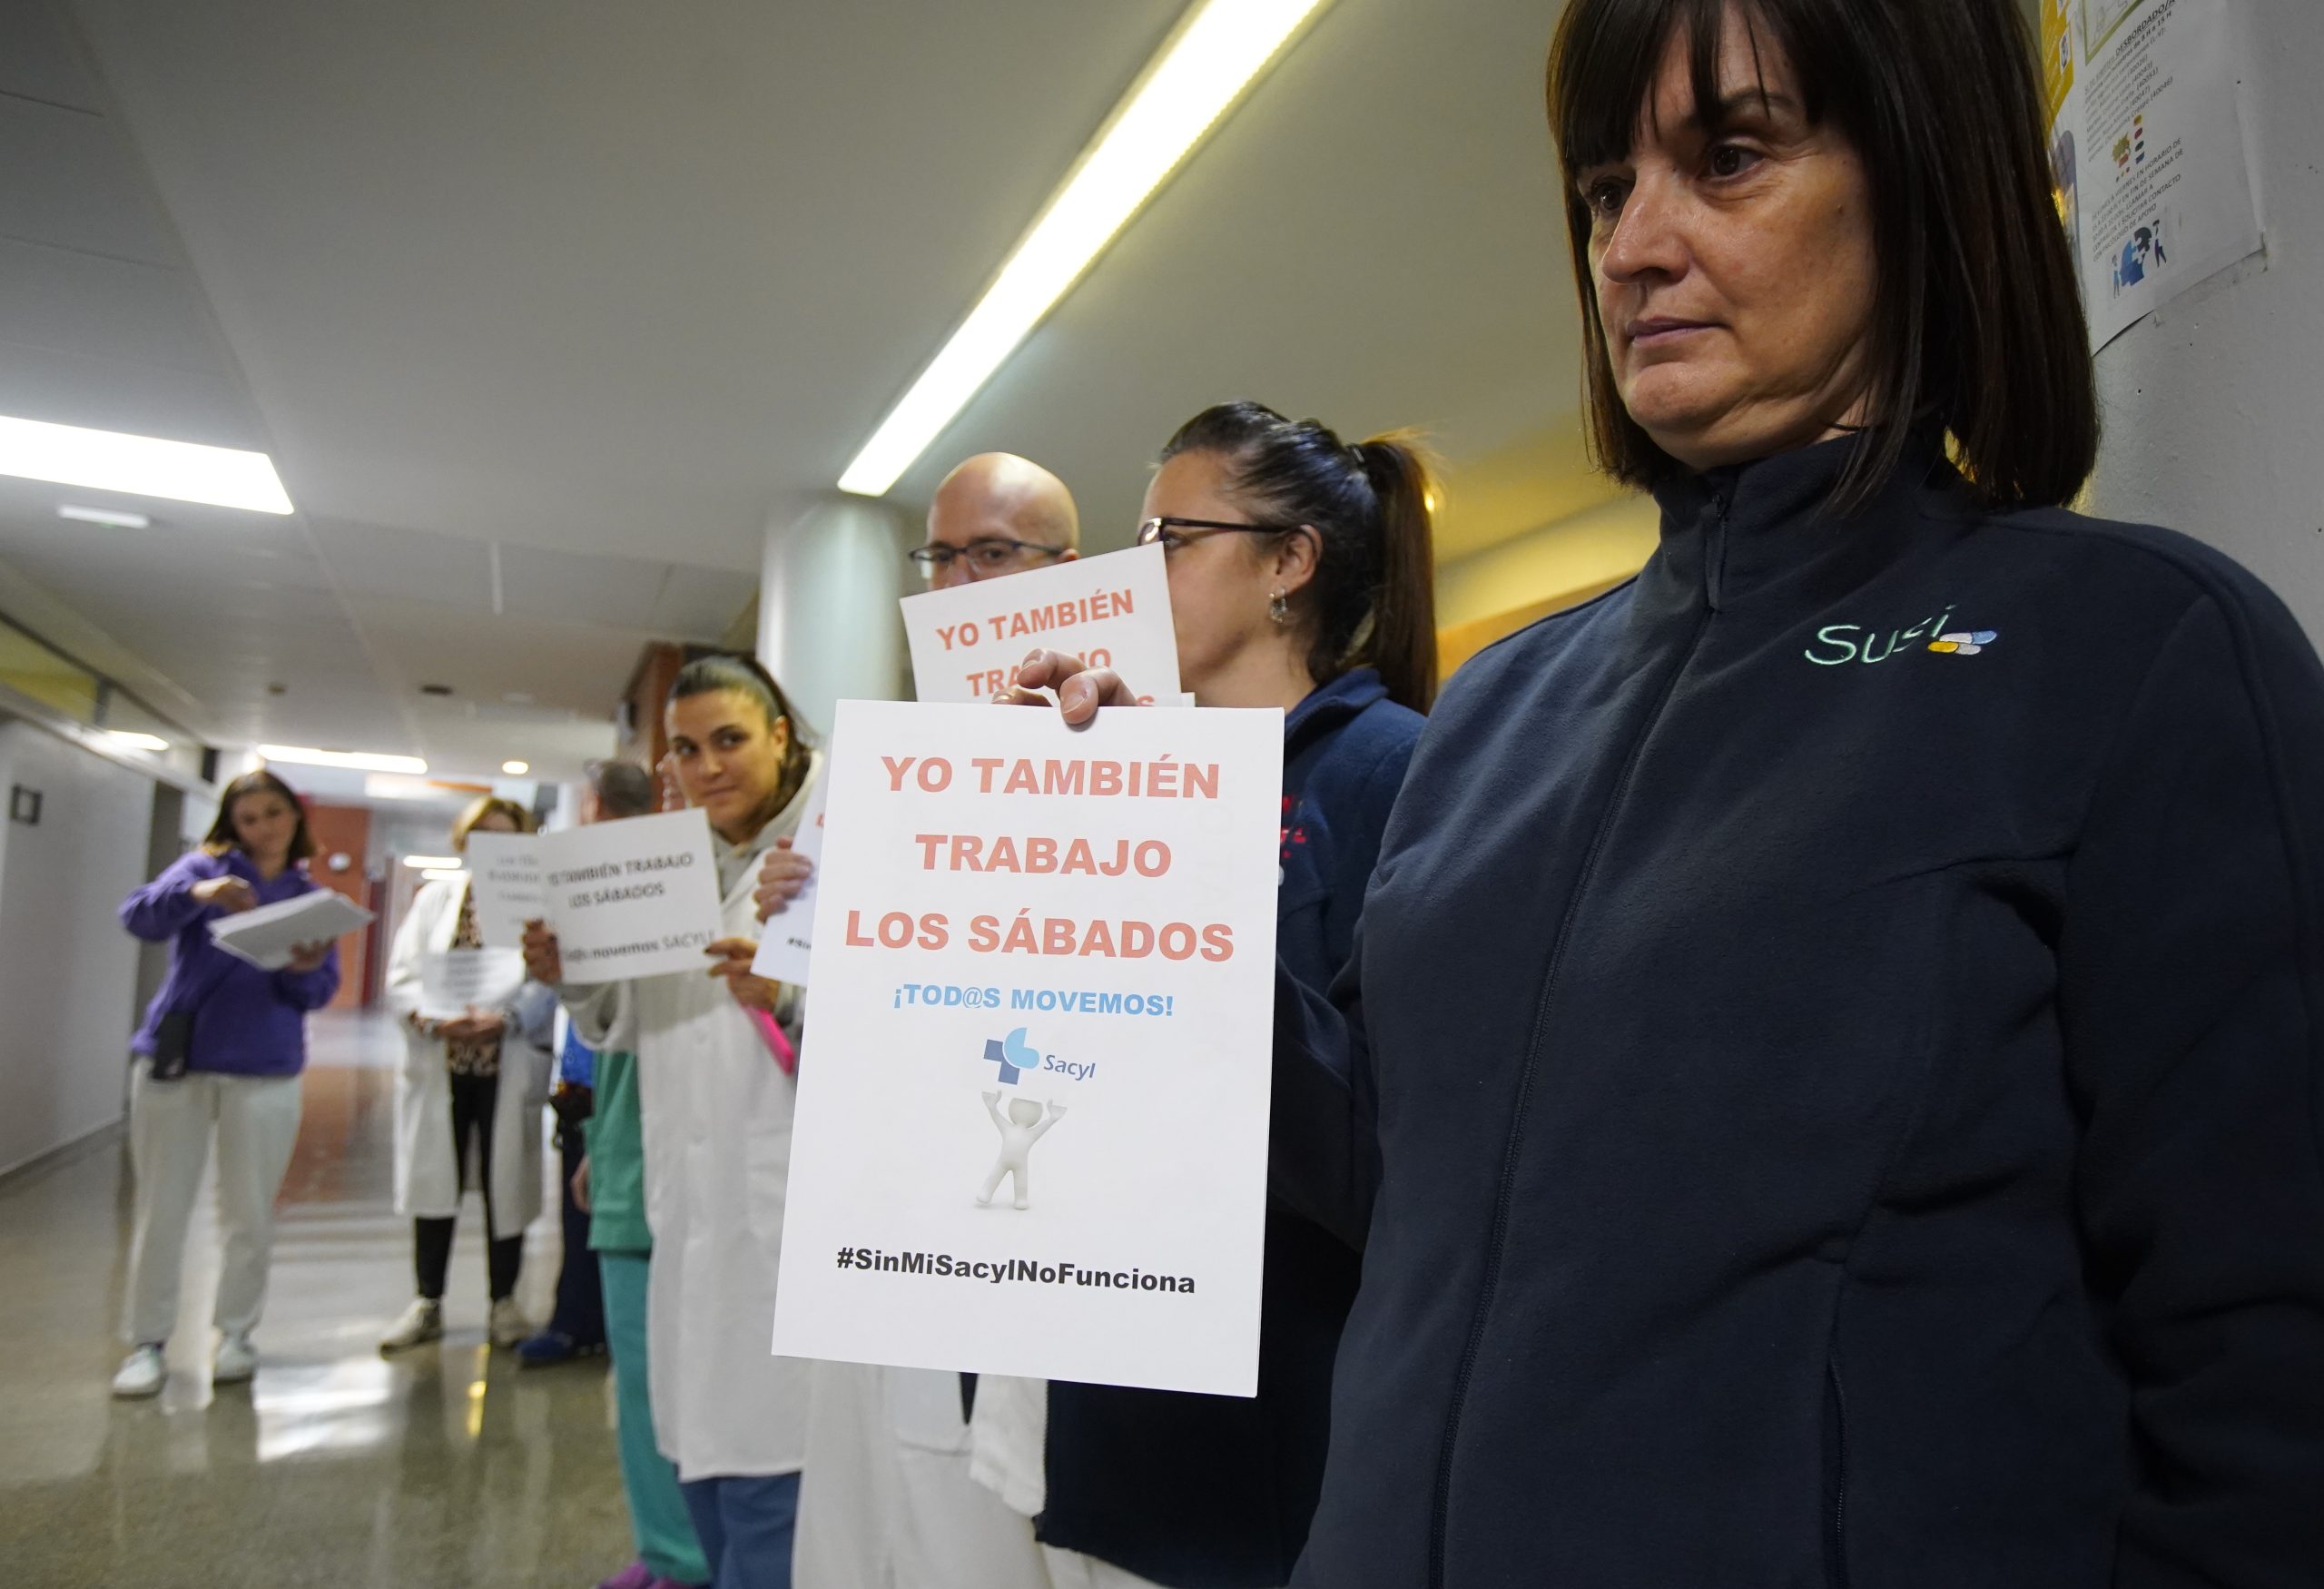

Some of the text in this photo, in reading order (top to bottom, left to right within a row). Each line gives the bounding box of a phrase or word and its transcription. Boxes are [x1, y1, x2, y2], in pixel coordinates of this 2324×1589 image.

[2145, 145, 2172, 171] HORARIO
[2172, 138, 2181, 149] DE
[2148, 156, 2174, 180] SEMANA
[2175, 149, 2184, 159] DE
[2148, 173, 2181, 202] CONTACTO
[936, 588, 1134, 651] YO TAMBIÉN
[881, 754, 1219, 799] YO TAMBIÉN
[625, 852, 694, 873] TRABAJO
[915, 834, 1172, 877] TRABAJO
[595, 881, 665, 906] SÁBADOS
[846, 908, 1234, 962] LOS SÁBADOS
[893, 983, 1174, 1017] ¡TOD@S MOVEMOS!
[1043, 1055, 1096, 1081] Sacyl
[836, 1247, 1196, 1294] #SinMiSacylNoFunciona
